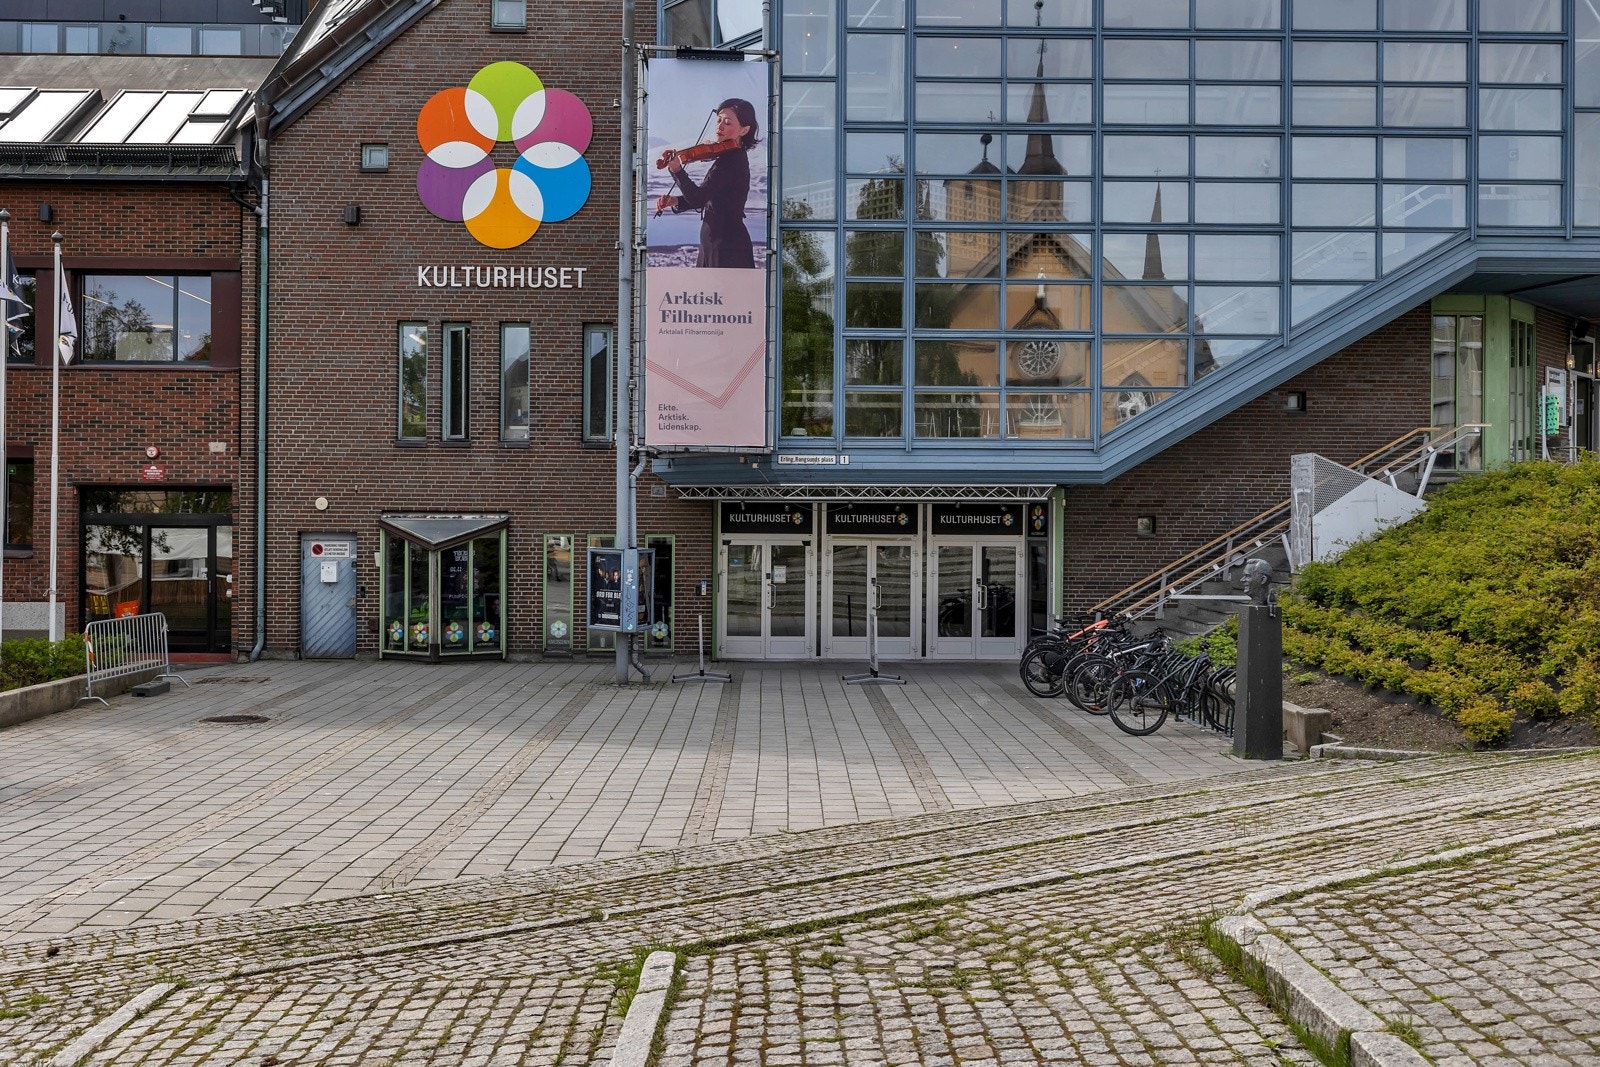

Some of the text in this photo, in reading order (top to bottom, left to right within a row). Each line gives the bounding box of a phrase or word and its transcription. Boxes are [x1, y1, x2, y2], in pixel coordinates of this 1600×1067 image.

[418, 265, 587, 288] KULTURHUSET
[659, 291, 723, 305] Arktisk
[659, 309, 752, 324] Filharmoni
[658, 404, 678, 412] Ekte.
[658, 413, 690, 421] Arktisk.
[658, 422, 702, 432] Lidenskap.
[729, 514, 791, 523] KULTURHUSET
[835, 514, 896, 523] KULTURHUSET
[940, 515, 1002, 524] KULTURHUSET
